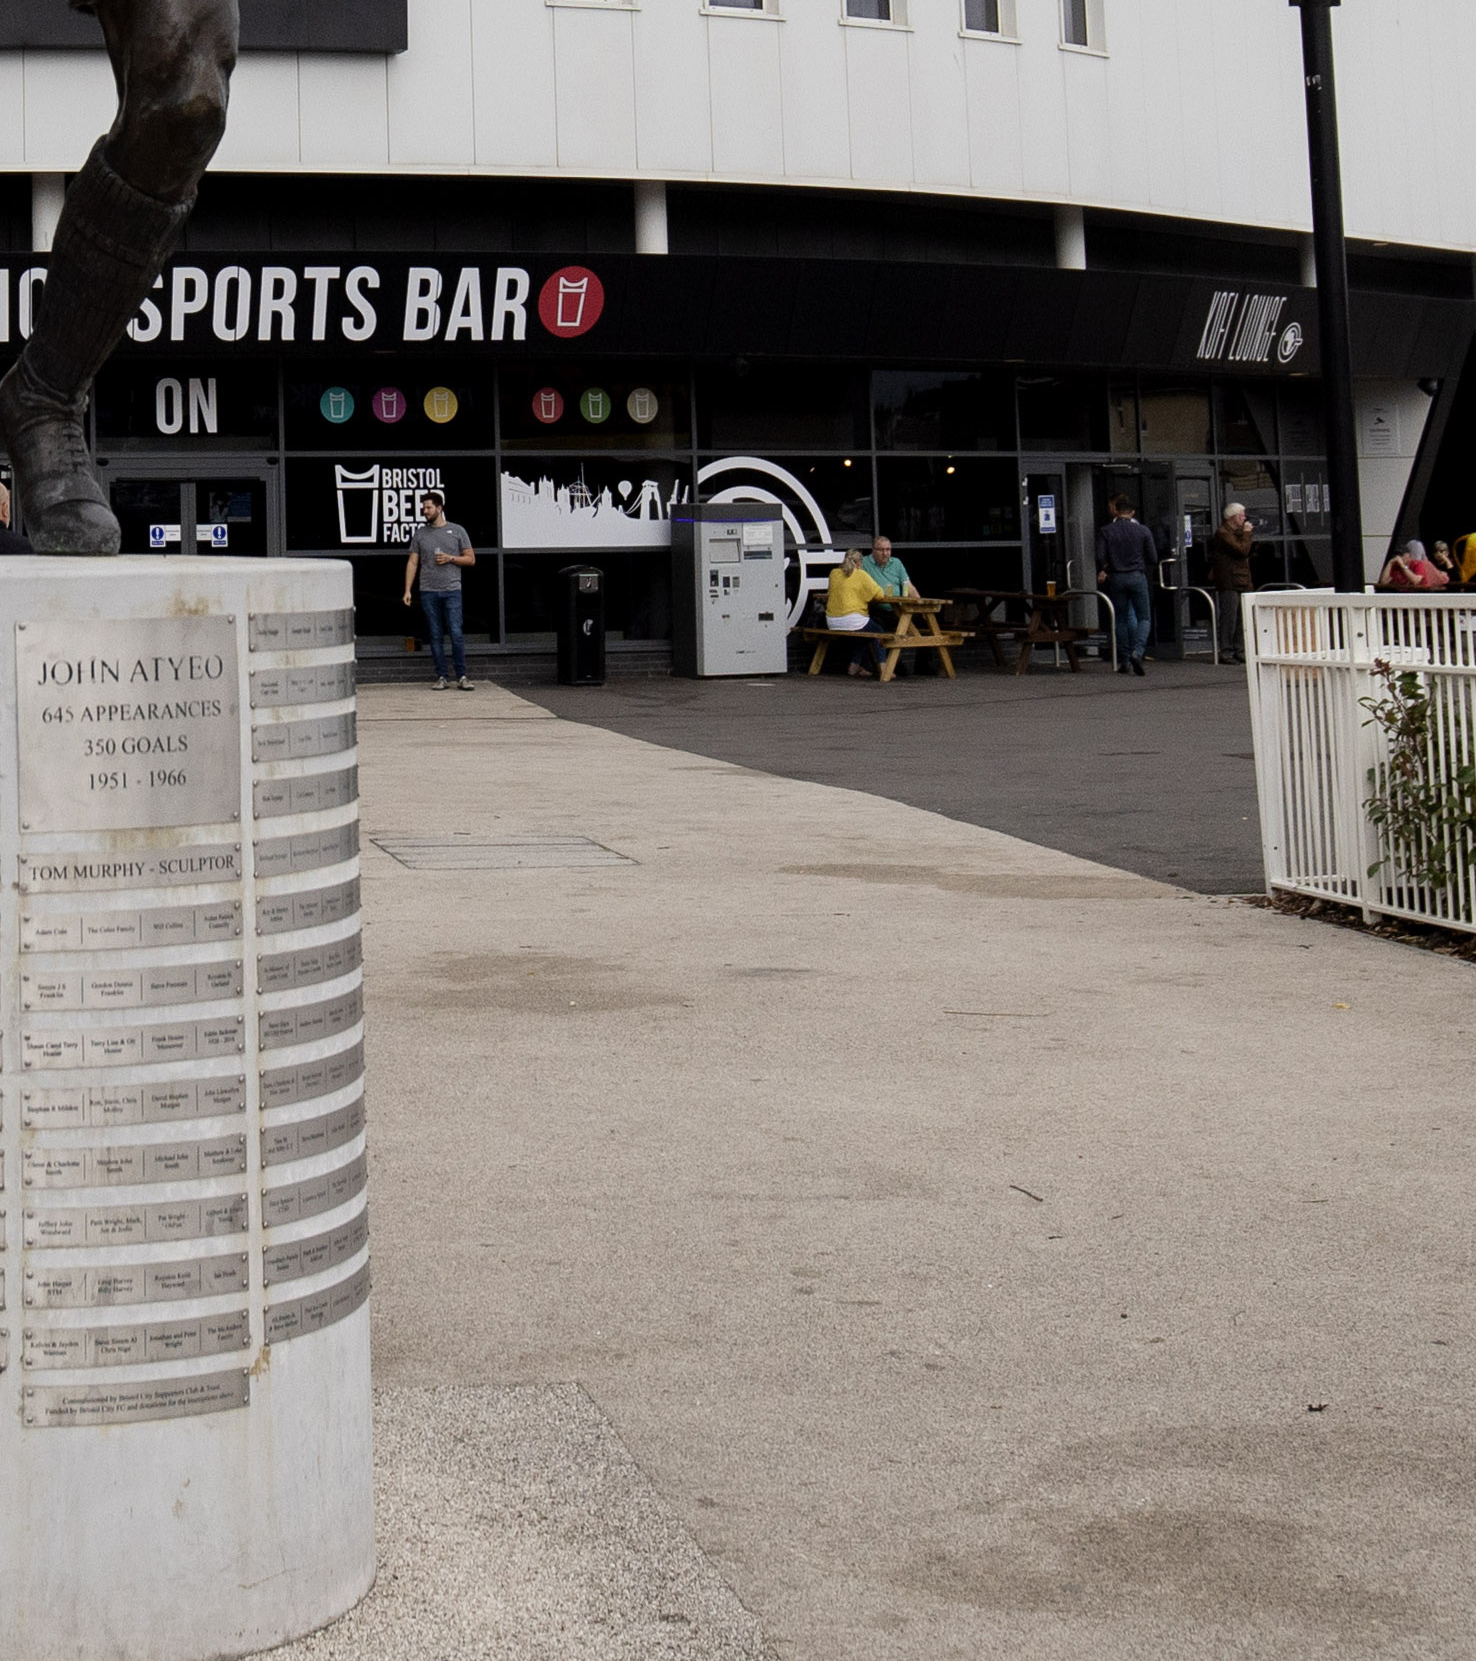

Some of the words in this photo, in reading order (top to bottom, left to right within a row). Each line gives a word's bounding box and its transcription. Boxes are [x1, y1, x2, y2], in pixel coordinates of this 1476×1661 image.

[403, 267, 531, 341] BAR
[155, 377, 218, 435] ON
[382, 468, 445, 488] BRISTOL
[37, 660, 120, 686] JOHN
[130, 654, 224, 684] ATYEO
[42, 706, 74, 724] 645
[80, 699, 222, 723] APPEARANCES
[84, 739, 117, 757] 350
[121, 735, 189, 755] GOALS
[88, 772, 128, 791] 1951
[149, 769, 187, 788] 1966
[29, 865, 68, 882] TOM
[73, 862, 146, 880] MURPHY
[158, 854, 235, 875] SCULPTOR
